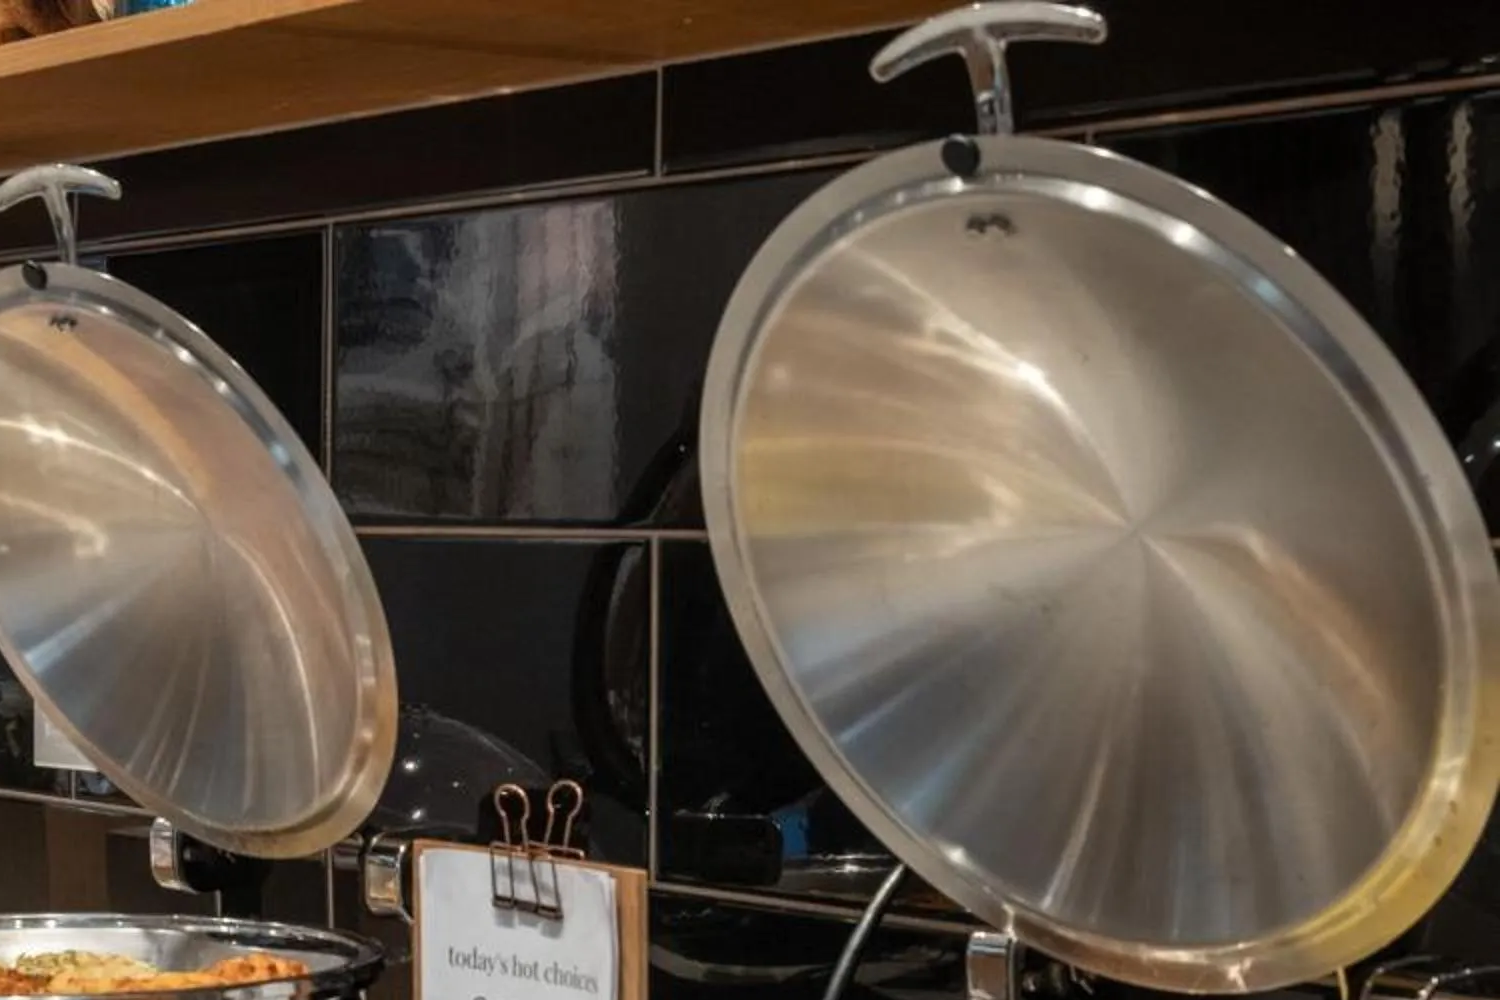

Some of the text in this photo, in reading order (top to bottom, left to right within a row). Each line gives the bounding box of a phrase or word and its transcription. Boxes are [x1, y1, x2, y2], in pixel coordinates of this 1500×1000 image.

[448, 946, 599, 994] today's hot choices
